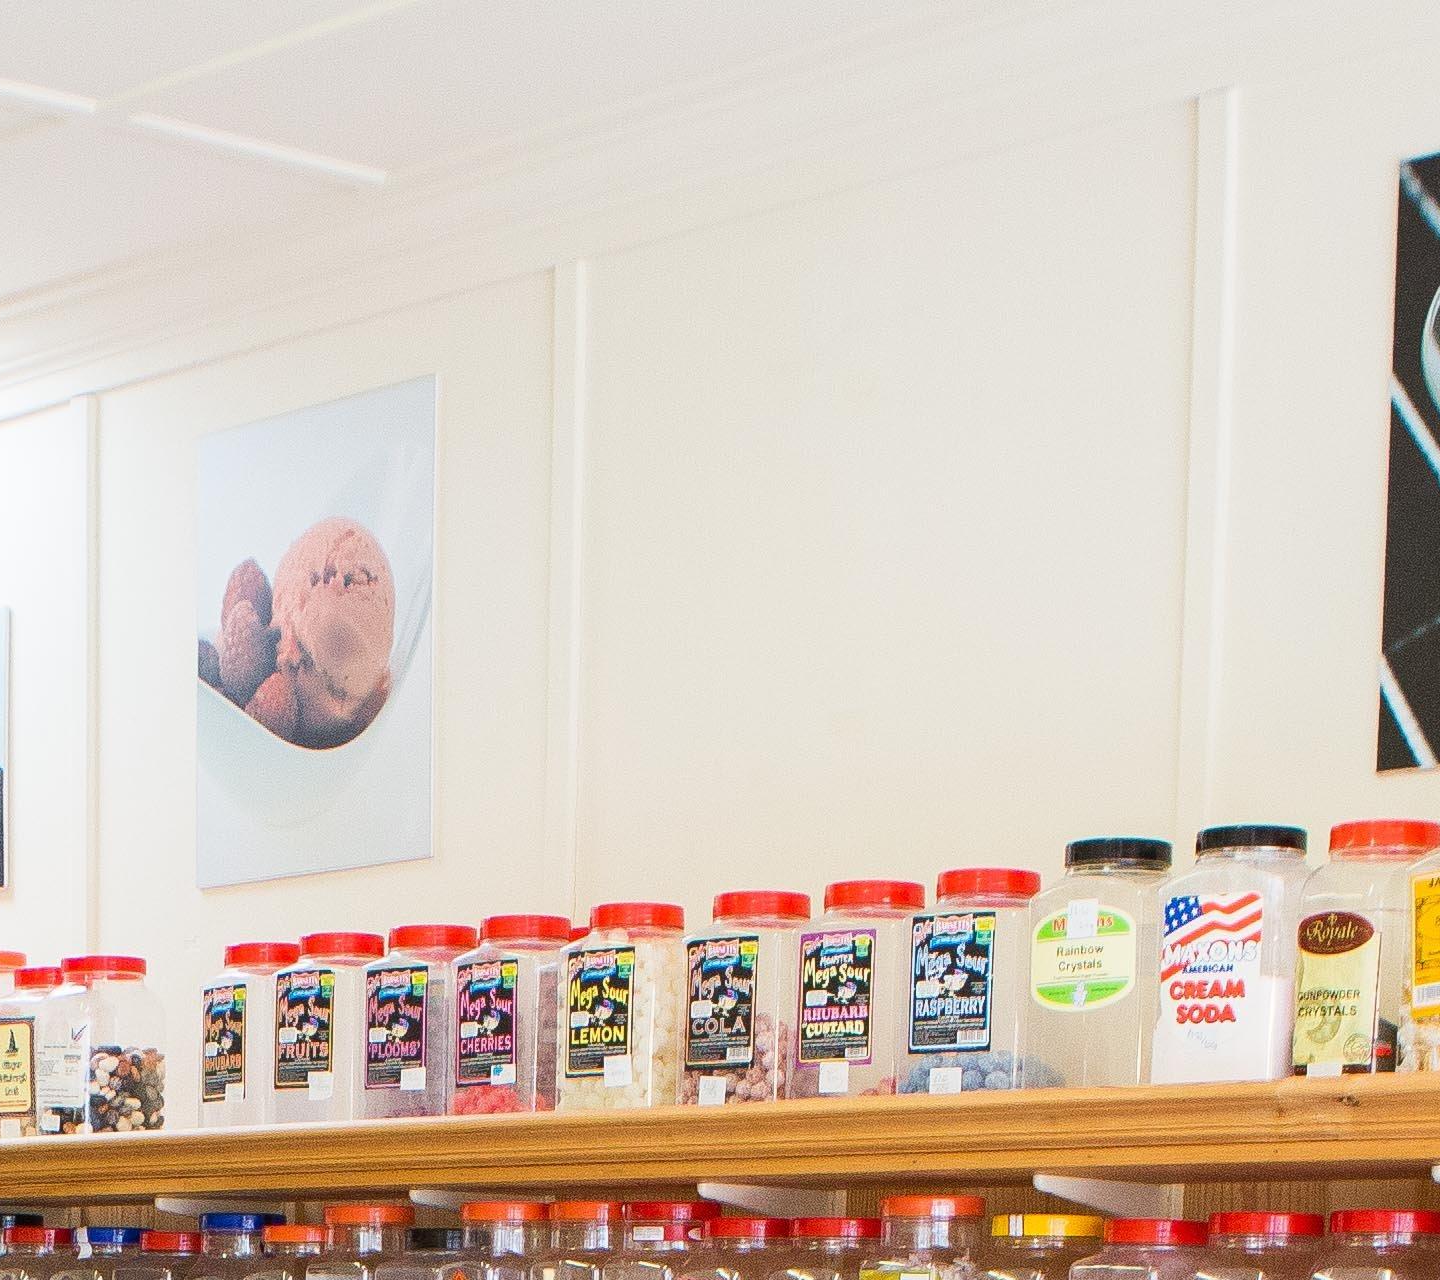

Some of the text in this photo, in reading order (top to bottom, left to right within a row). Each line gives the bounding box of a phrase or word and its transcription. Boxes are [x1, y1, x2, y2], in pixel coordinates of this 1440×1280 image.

[1304, 919, 1361, 945] Royale
[1056, 943, 1104, 958] Rainbow
[1058, 956, 1103, 973] Crystals
[1170, 978, 1245, 1001] CREAM
[914, 996, 986, 1017] RASPBERRY
[1176, 1001, 1236, 1026] SODA
[571, 1025, 625, 1045] LEMON
[691, 1018, 747, 1036] COLA
